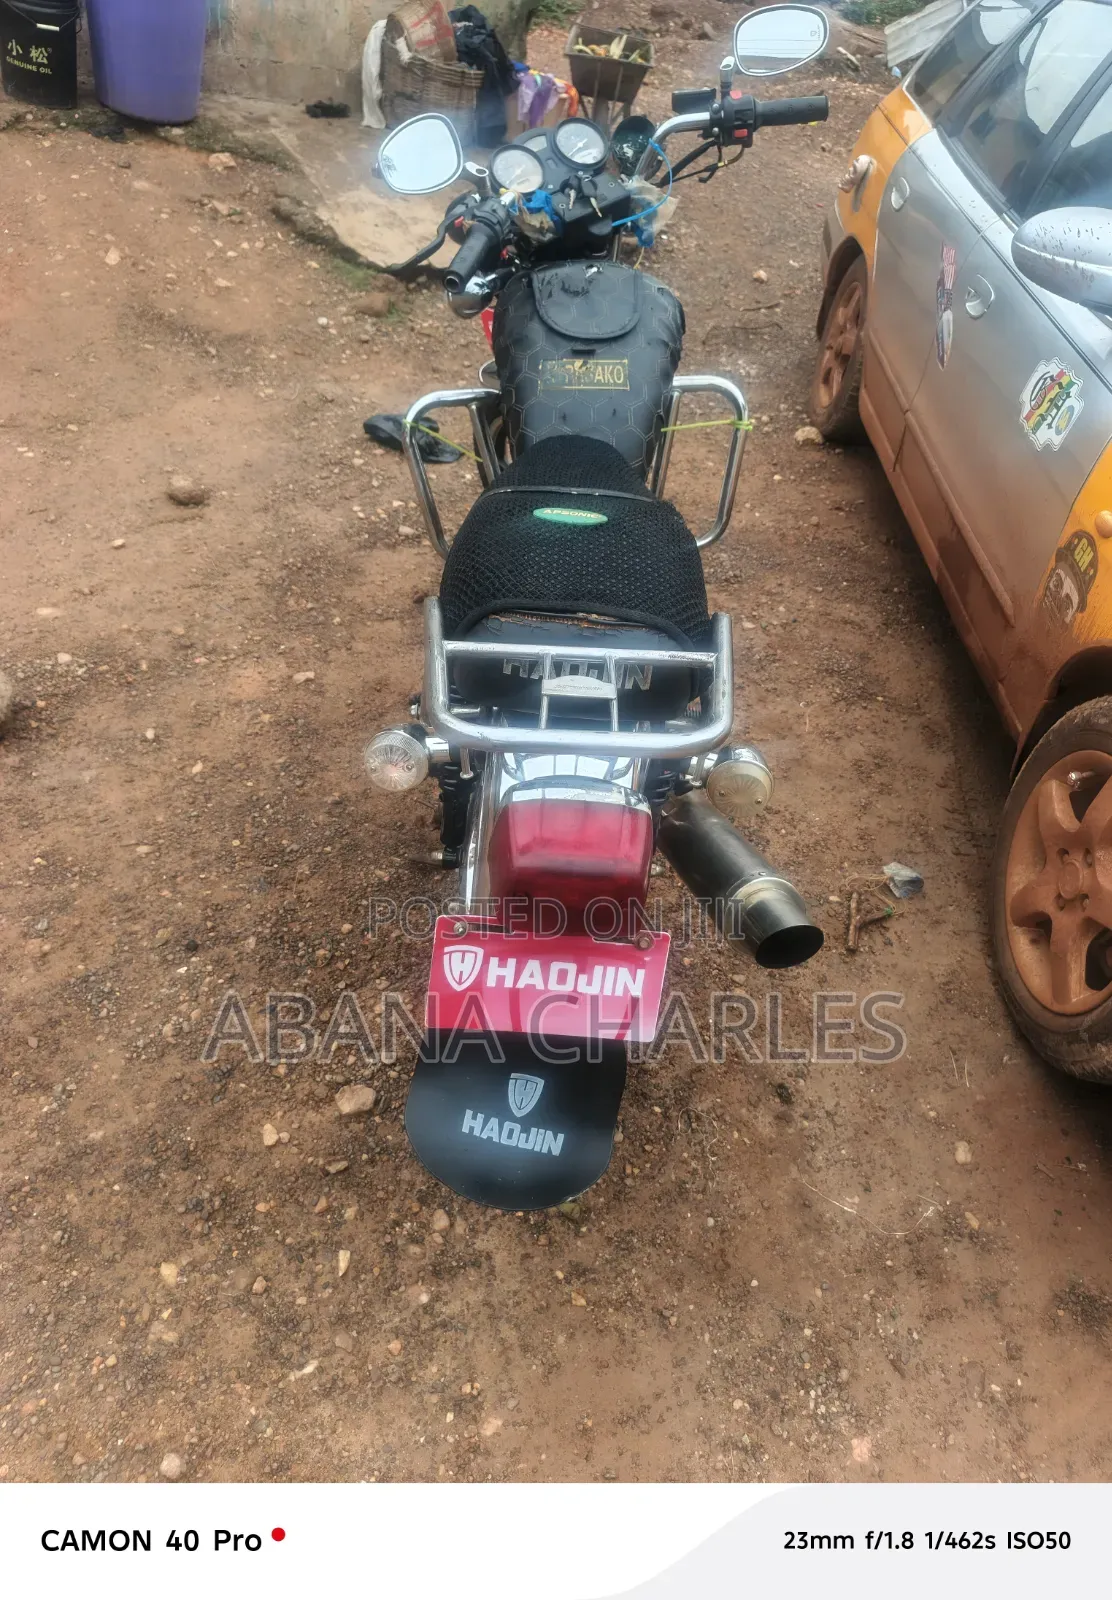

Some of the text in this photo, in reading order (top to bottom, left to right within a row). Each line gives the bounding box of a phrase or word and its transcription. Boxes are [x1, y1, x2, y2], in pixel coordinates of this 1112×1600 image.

[7, 39, 49, 64] 小松
[6, 56, 53, 75] GENUINE OIL
[542, 509, 600, 519] APSONIC
[486, 956, 646, 997] HAOJIN
[461, 1108, 565, 1157] HAOJIN
